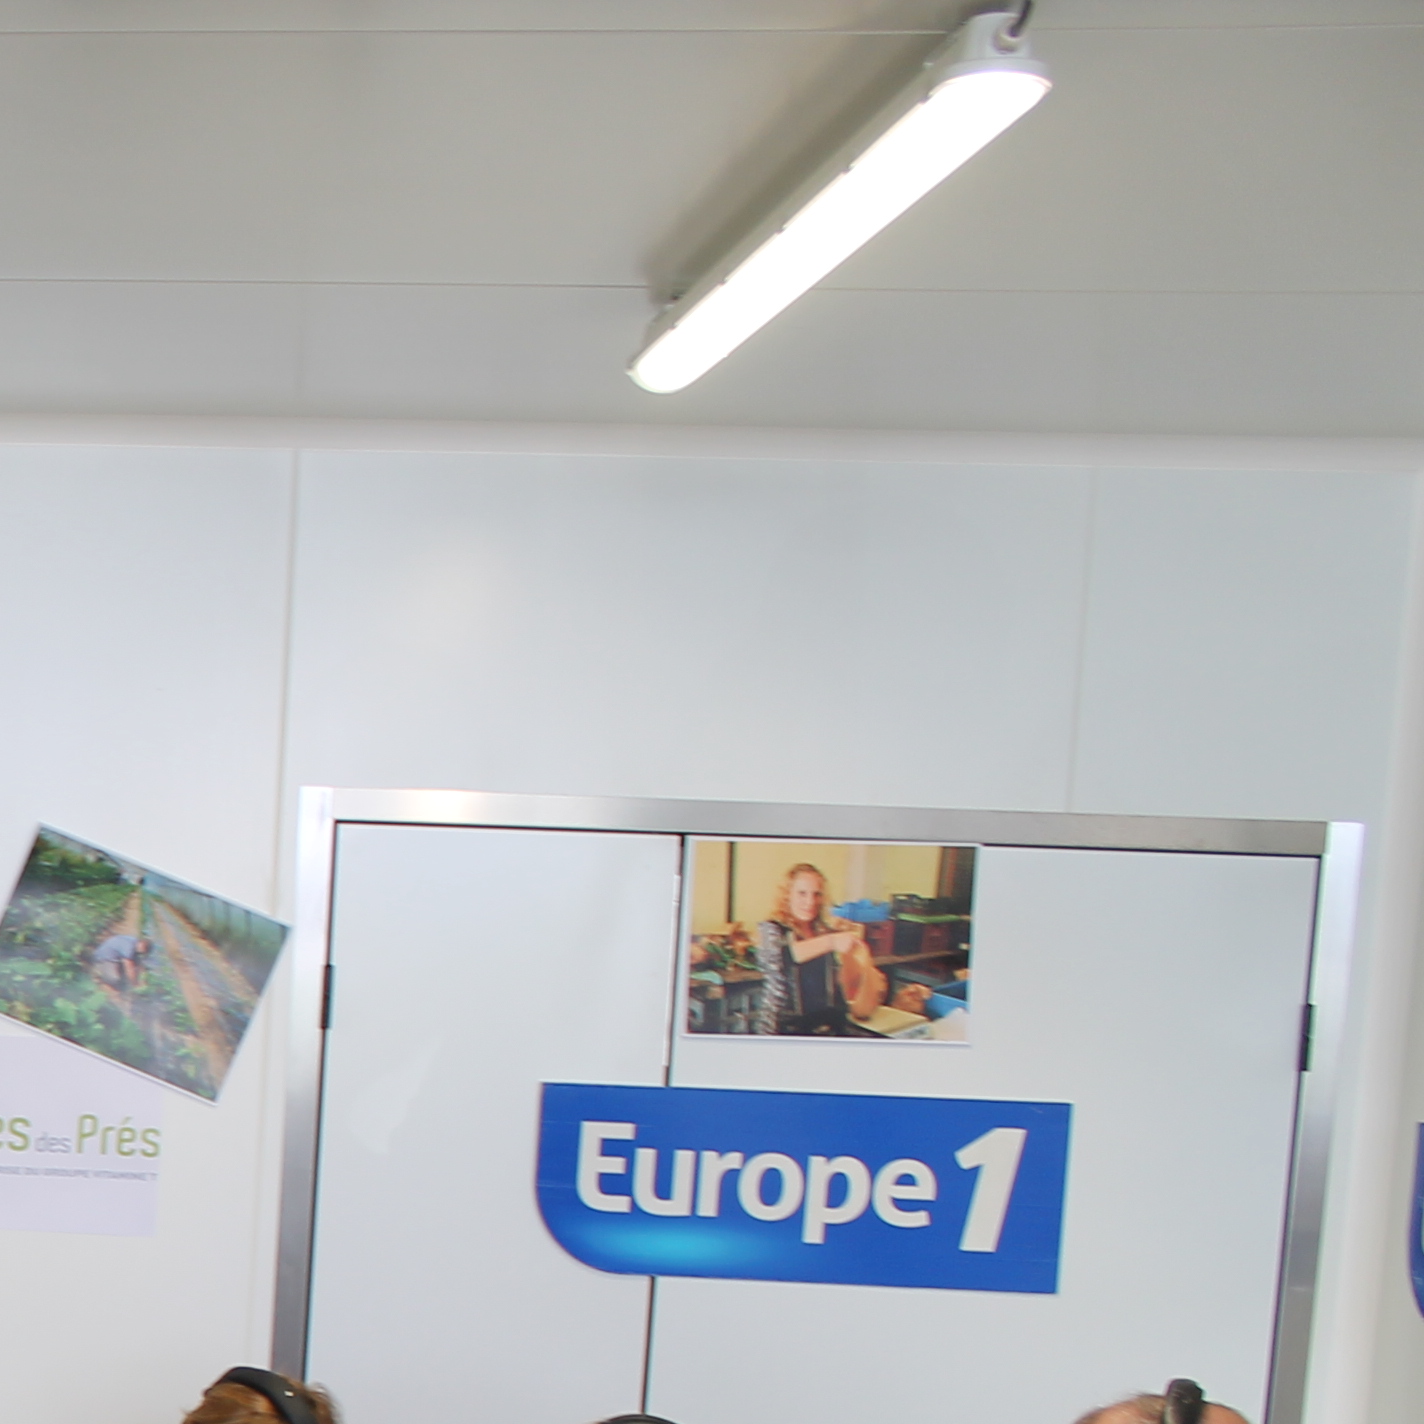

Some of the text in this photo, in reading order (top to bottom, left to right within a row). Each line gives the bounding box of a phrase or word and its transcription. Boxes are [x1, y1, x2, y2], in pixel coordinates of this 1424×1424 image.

[34, 1131, 72, 1154] des
[75, 1113, 162, 1158] Prés
[576, 1119, 1029, 1254] Europe 1
